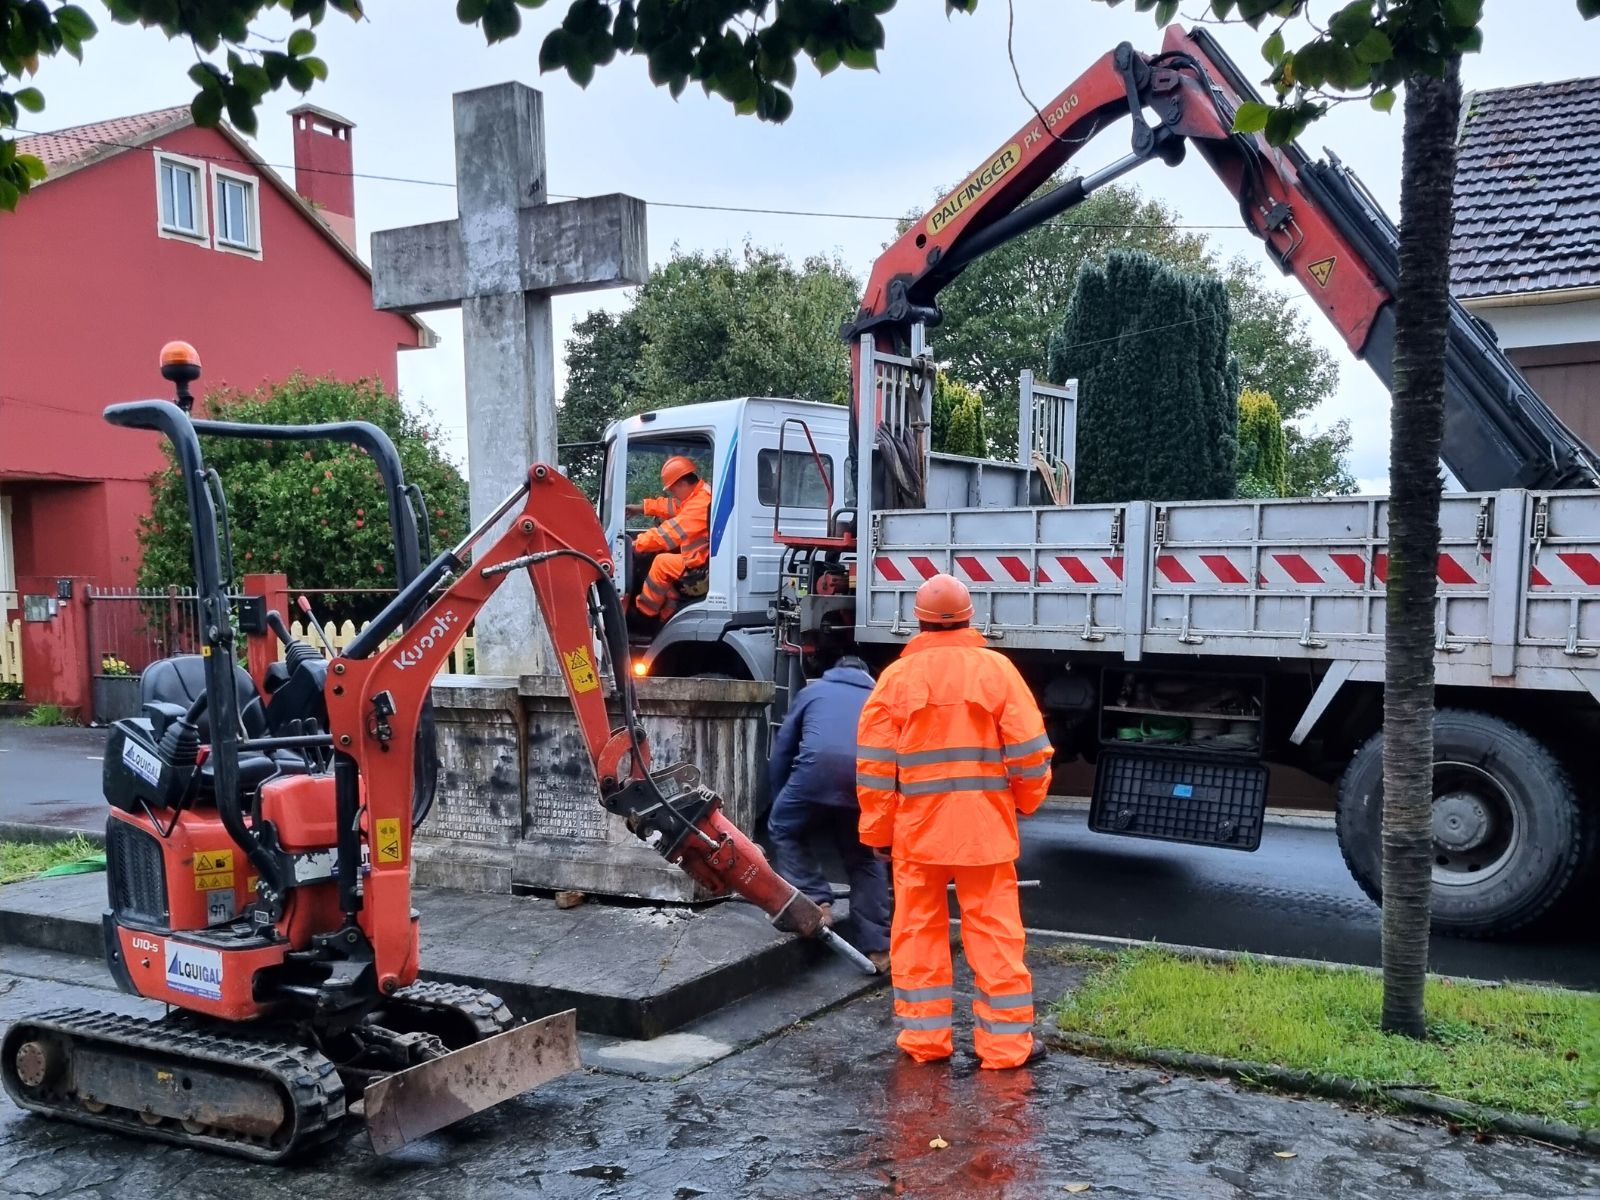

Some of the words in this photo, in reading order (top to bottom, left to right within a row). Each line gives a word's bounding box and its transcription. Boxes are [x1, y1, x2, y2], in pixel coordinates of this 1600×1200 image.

[931, 149, 1015, 230] PALFINGER
[1023, 127, 1042, 149] PK
[168, 951, 221, 985] ALQUIGAL
